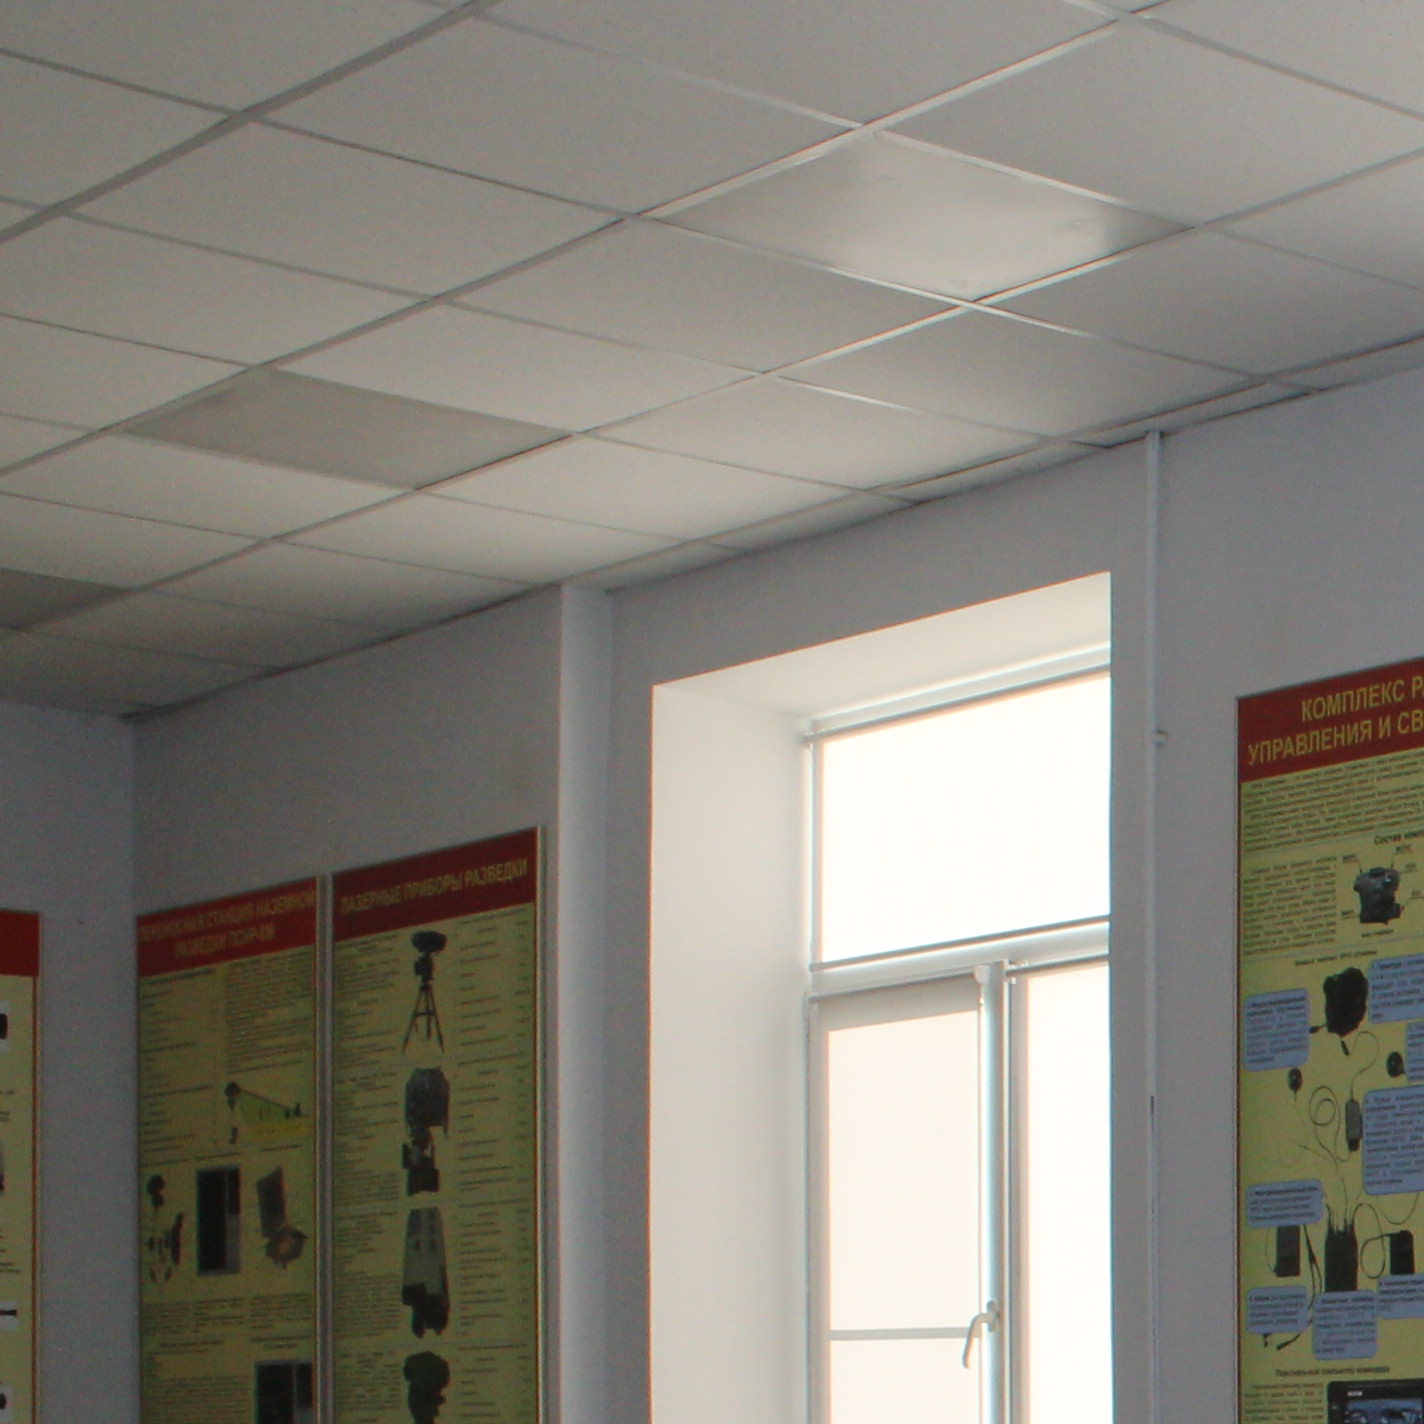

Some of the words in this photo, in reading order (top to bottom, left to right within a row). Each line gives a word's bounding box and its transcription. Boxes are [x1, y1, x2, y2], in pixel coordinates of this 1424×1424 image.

[1302, 680, 1405, 722] КОМПЛЕКС
[1248, 720, 1372, 765] УПРАВЛЕНИЯ
[1378, 715, 1391, 739] И
[465, 858, 528, 887] РАЗВЕДКИ
